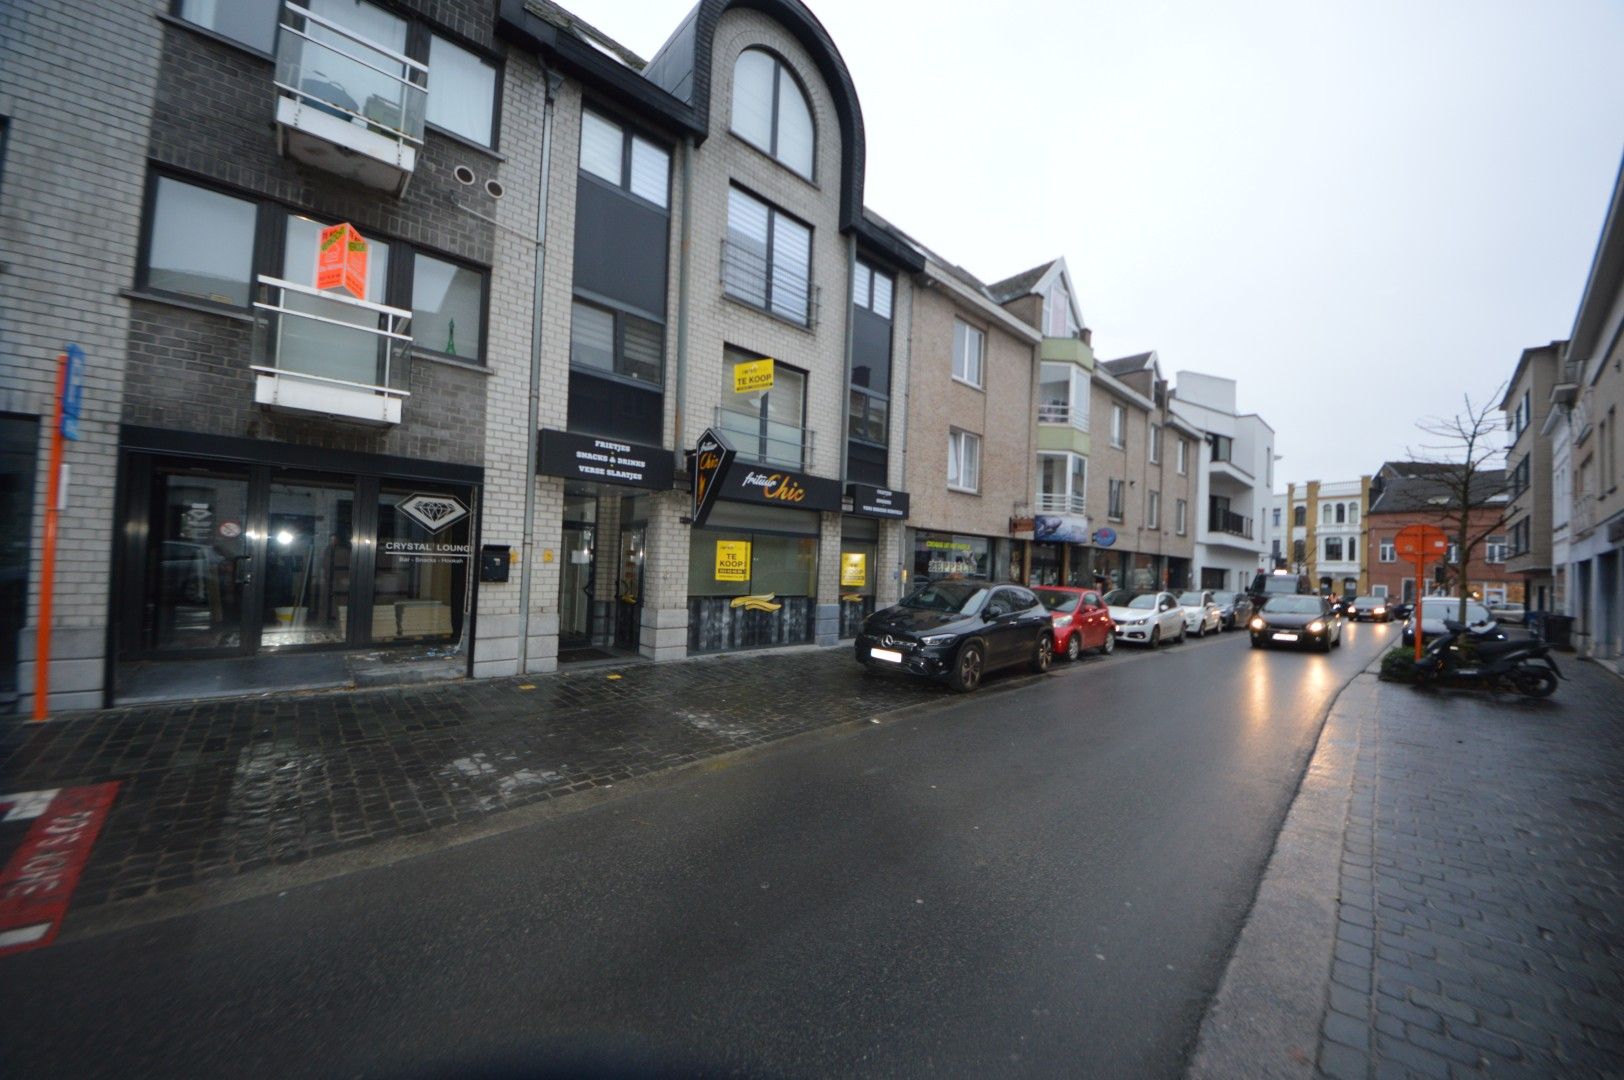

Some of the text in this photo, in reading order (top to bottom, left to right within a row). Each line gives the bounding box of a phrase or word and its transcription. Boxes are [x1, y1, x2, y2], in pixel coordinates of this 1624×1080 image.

[737, 373, 772, 385] TE KOOP
[594, 439, 631, 453] FRIETJES
[576, 450, 609, 463] SNACKS
[617, 457, 646, 469] DRINKS
[578, 465, 643, 481] VERSE SLAATJES
[742, 471, 806, 502] frituur Chic
[385, 542, 472, 553] CRYSTAL LOUNG
[719, 560, 743, 568] KOOP
